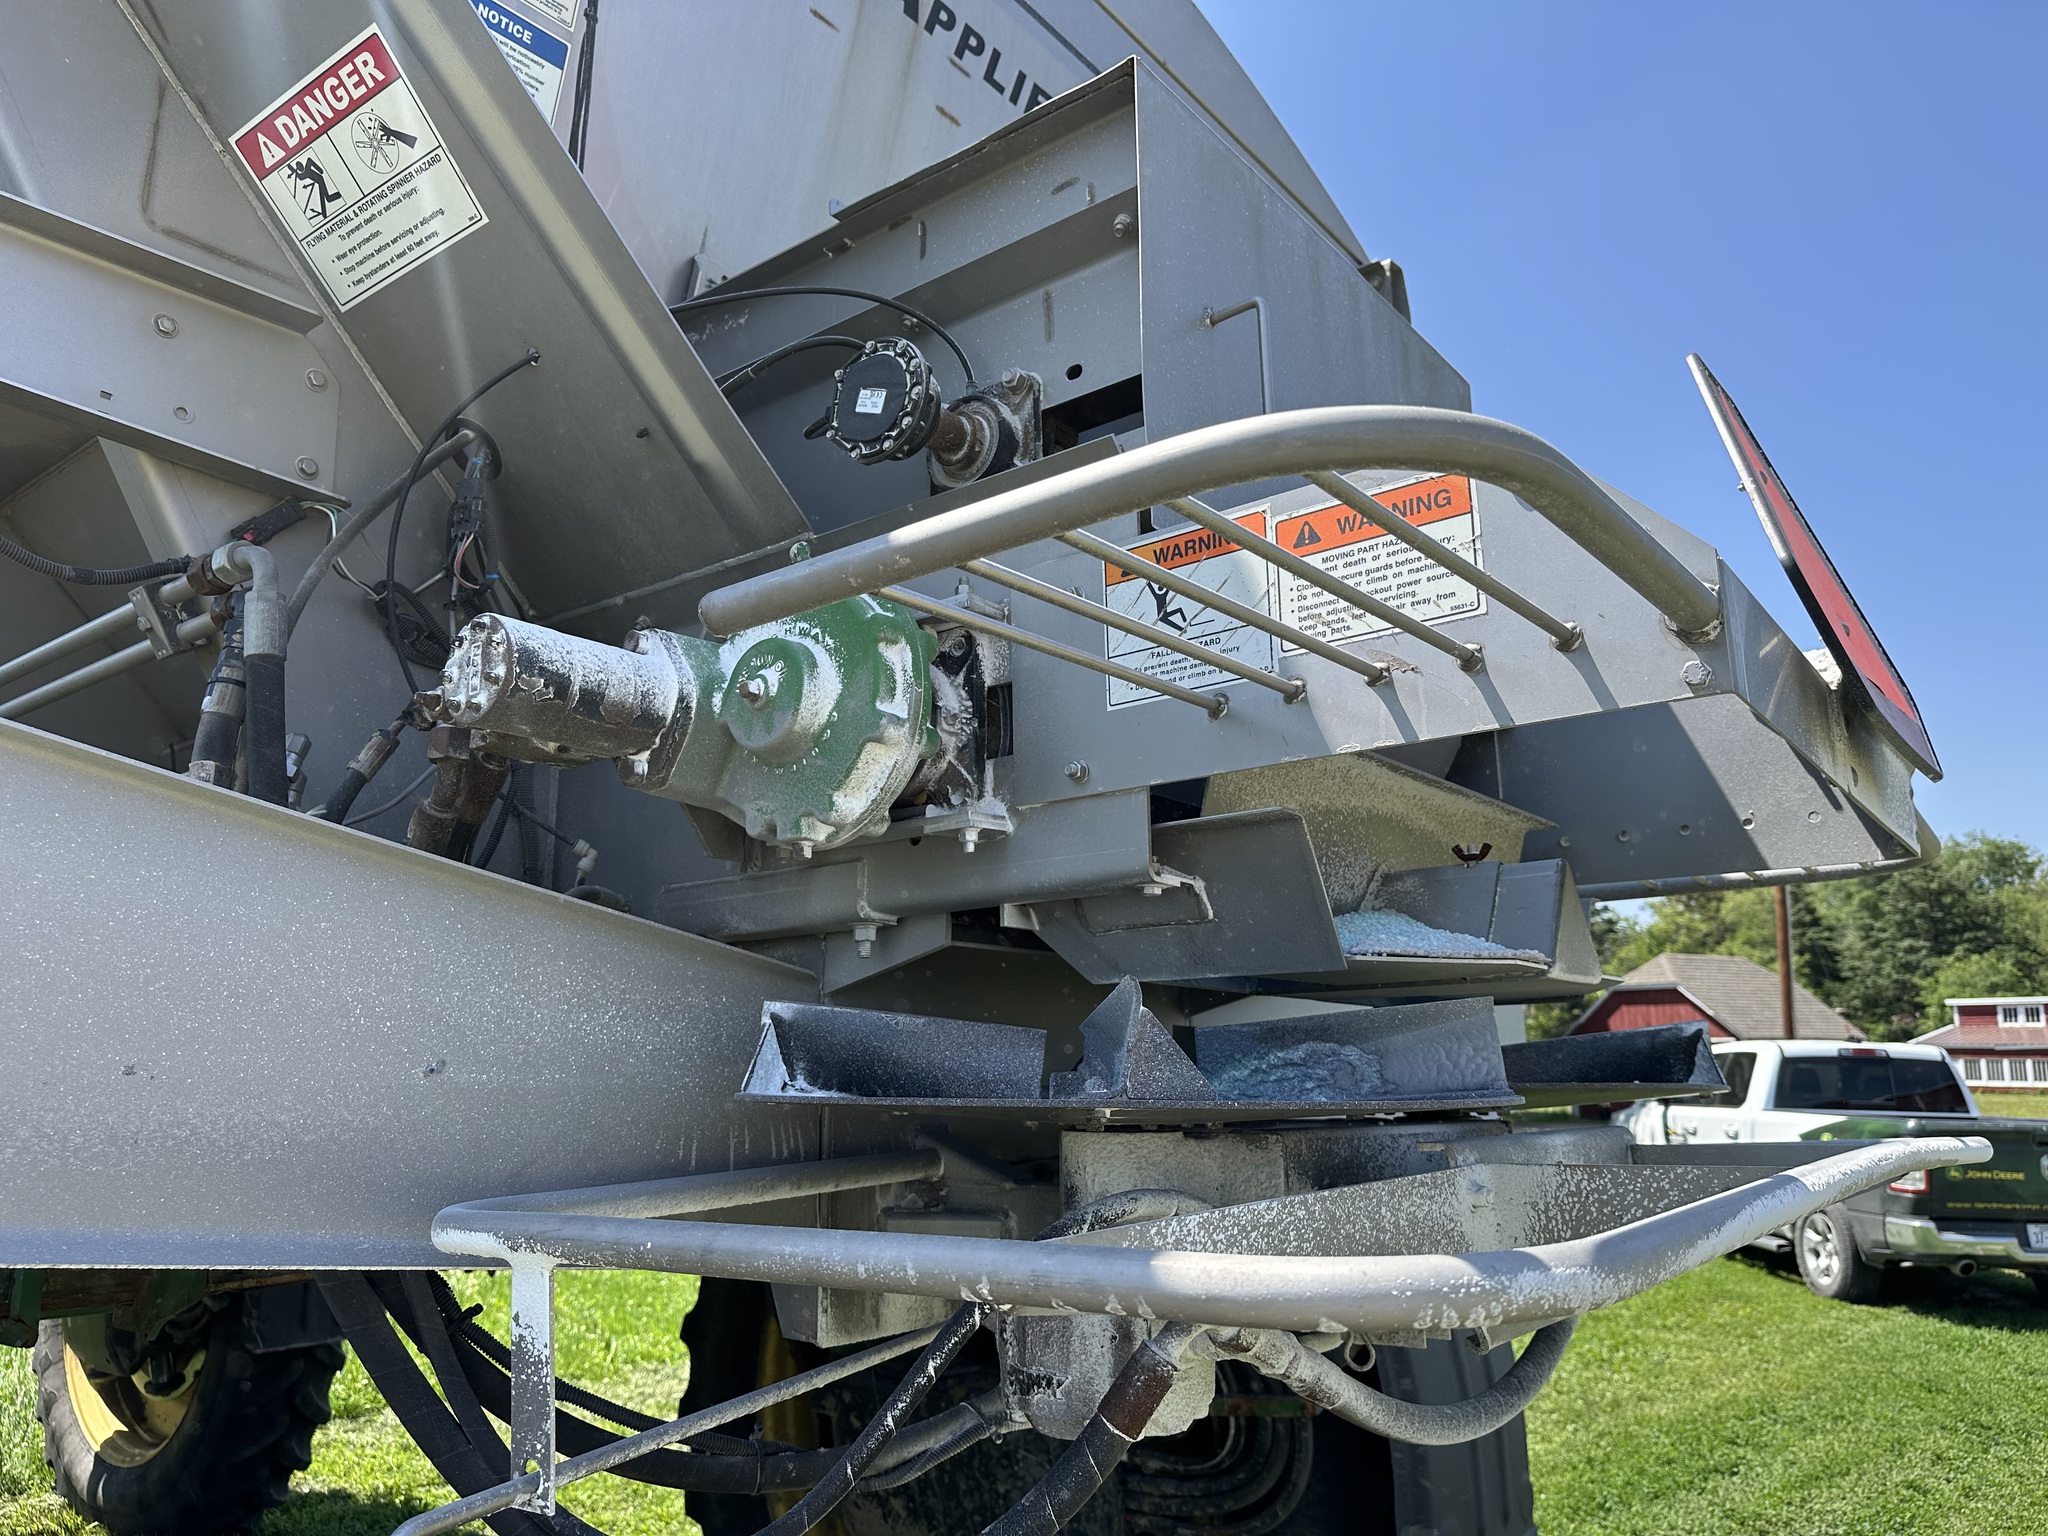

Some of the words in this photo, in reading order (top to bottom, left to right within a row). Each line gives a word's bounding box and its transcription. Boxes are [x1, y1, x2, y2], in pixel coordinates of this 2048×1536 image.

[478, 3, 533, 44] NOTICE
[274, 51, 386, 149] DANGER
[306, 232, 327, 249] FLYING
[325, 214, 354, 237] MATERIAL
[352, 209, 360, 218] &
[357, 190, 388, 215] ROTATING
[386, 171, 416, 195] SPINNER
[413, 153, 442, 177] HAZARD
[345, 221, 364, 239] prevent
[363, 212, 379, 226] death
[376, 208, 384, 217] or
[382, 195, 403, 213] serious
[400, 185, 420, 201] injury:
[335, 251, 349, 262] Wear
[347, 245, 358, 255] eye
[356, 230, 383, 250] protection.
[343, 264, 356, 275] Stop
[355, 252, 376, 268] machine
[374, 241, 391, 255] before
[390, 227, 415, 245] servicing
[412, 223, 420, 231] or
[419, 207, 446, 227] adjusting.
[351, 276, 366, 287] Keep
[363, 260, 391, 280] bystanders
[389, 255, 397, 264] at
[393, 247, 409, 260] least
[406, 243, 415, 253] 60
[412, 237, 426, 248] feet
[424, 229, 440, 242] away.
[1336, 488, 1452, 535] WANING
[1153, 531, 1233, 565] WARNIN
[1321, 550, 1355, 565] MOVING
[1357, 543, 1380, 556] PART
[1382, 537, 1403, 550] HAZ
[1342, 556, 1367, 569] death
[1371, 553, 1381, 562] or
[1386, 546, 1415, 558] seriou
[1296, 583, 1317, 592] Clos
[1337, 571, 1363, 581] ecure
[1364, 563, 1393, 577] guards
[1395, 555, 1422, 568] before
[1297, 594, 1308, 602] Do
[1311, 590, 1324, 599] not
[1366, 574, 1388, 585] climb
[1297, 598, 1340, 613] Disconnect
[1396, 578, 1422, 591] power
[1298, 623, 1318, 632] Keep
[1321, 617, 1348, 629] hands,
[1351, 612, 1367, 620] feet
[1410, 597, 1432, 608] away
[1436, 591, 1456, 601] from
[1298, 612, 1322, 623] before
[1326, 603, 1361, 616] adjustin
[1331, 624, 1353, 637] parts.
[1143, 662, 1169, 673] prevent
[1170, 657, 1191, 667] death,
[1160, 664, 1188, 676] machine
[1188, 671, 1207, 680] climb
[1965, 1171, 1992, 1179] JOHN
[1993, 1170, 2025, 1181] DEERE
